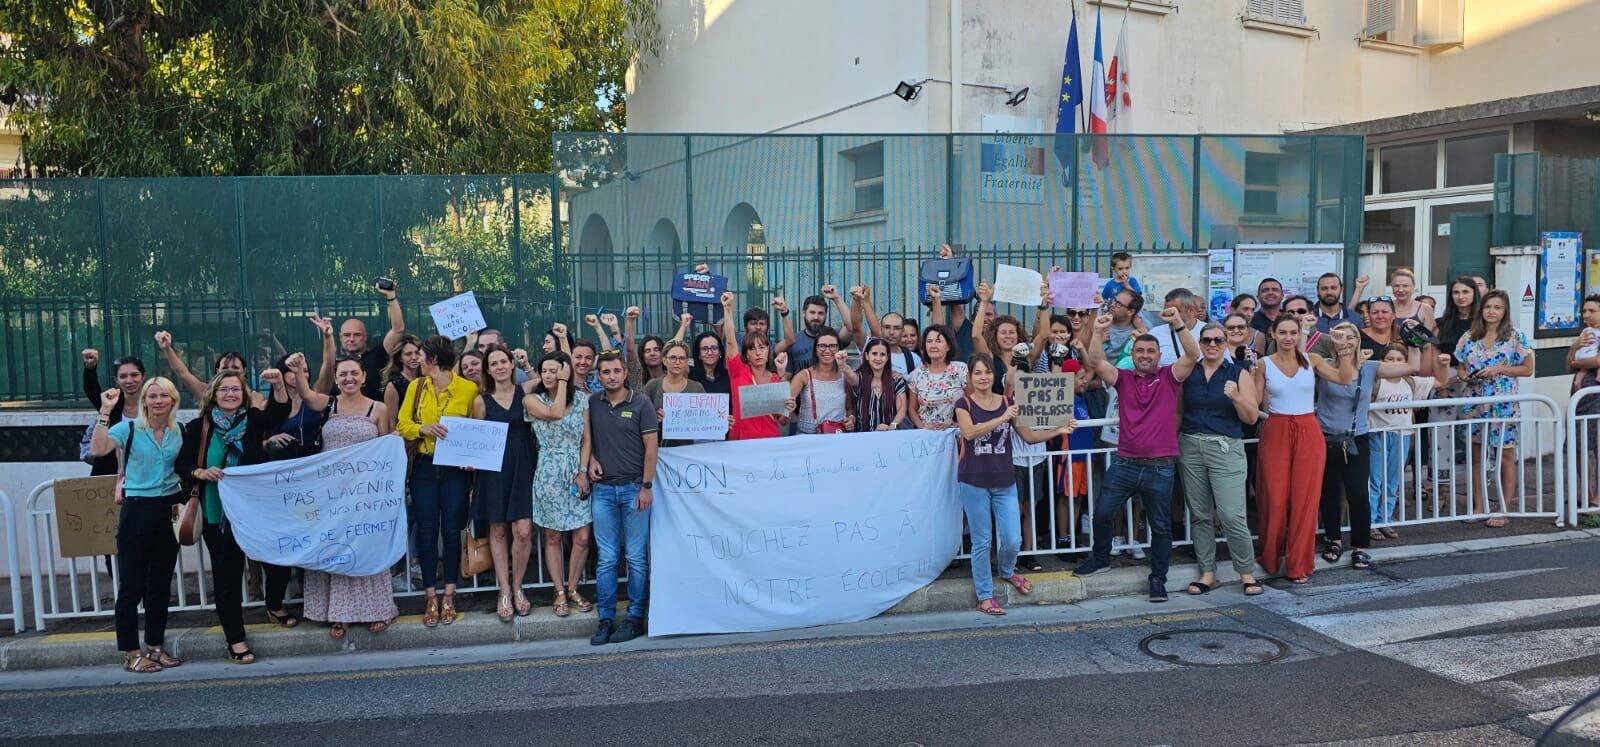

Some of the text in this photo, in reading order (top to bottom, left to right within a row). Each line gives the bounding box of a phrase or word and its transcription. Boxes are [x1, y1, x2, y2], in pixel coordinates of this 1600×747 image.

[984, 174, 1043, 190] Fraternité
[1018, 376, 1067, 390] TOUCHE
[1027, 389, 1052, 404] PAS
[1035, 416, 1050, 426] !!!
[274, 470, 301, 486] NE
[663, 462, 728, 490] NON
[283, 490, 316, 507] PAS
[305, 509, 321, 522] DE
[278, 535, 312, 554] PAS
[319, 528, 337, 543] DE
[687, 519, 812, 561] TOUCHEZ
[832, 514, 882, 545] PAS
[721, 576, 818, 608] NOTRE
